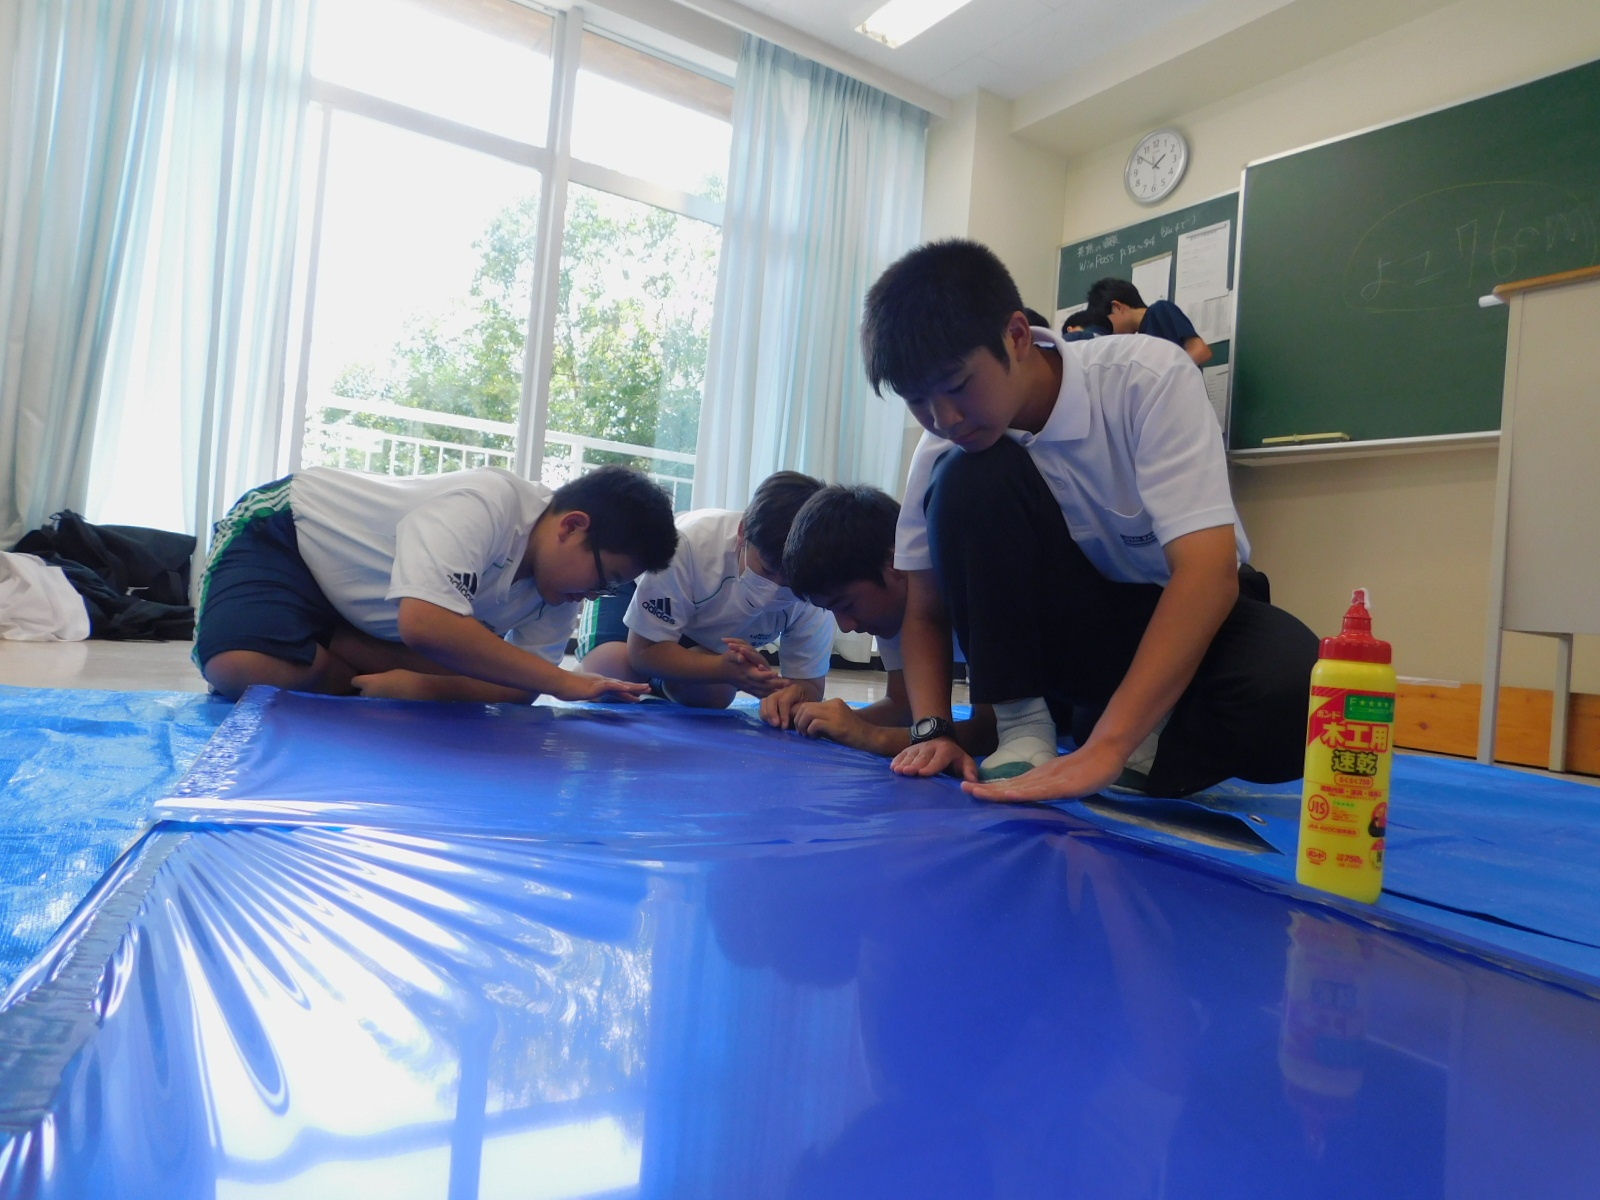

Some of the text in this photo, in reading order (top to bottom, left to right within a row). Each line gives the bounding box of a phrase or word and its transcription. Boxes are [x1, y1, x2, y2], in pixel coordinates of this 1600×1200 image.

[1152, 139, 1160, 148] 12
[641, 600, 676, 626] adidas
[1316, 709, 1341, 720] ボンド
[1321, 721, 1389, 752] 木工用
[1332, 749, 1378, 776] 速乾
[1308, 801, 1325, 815] JIS
